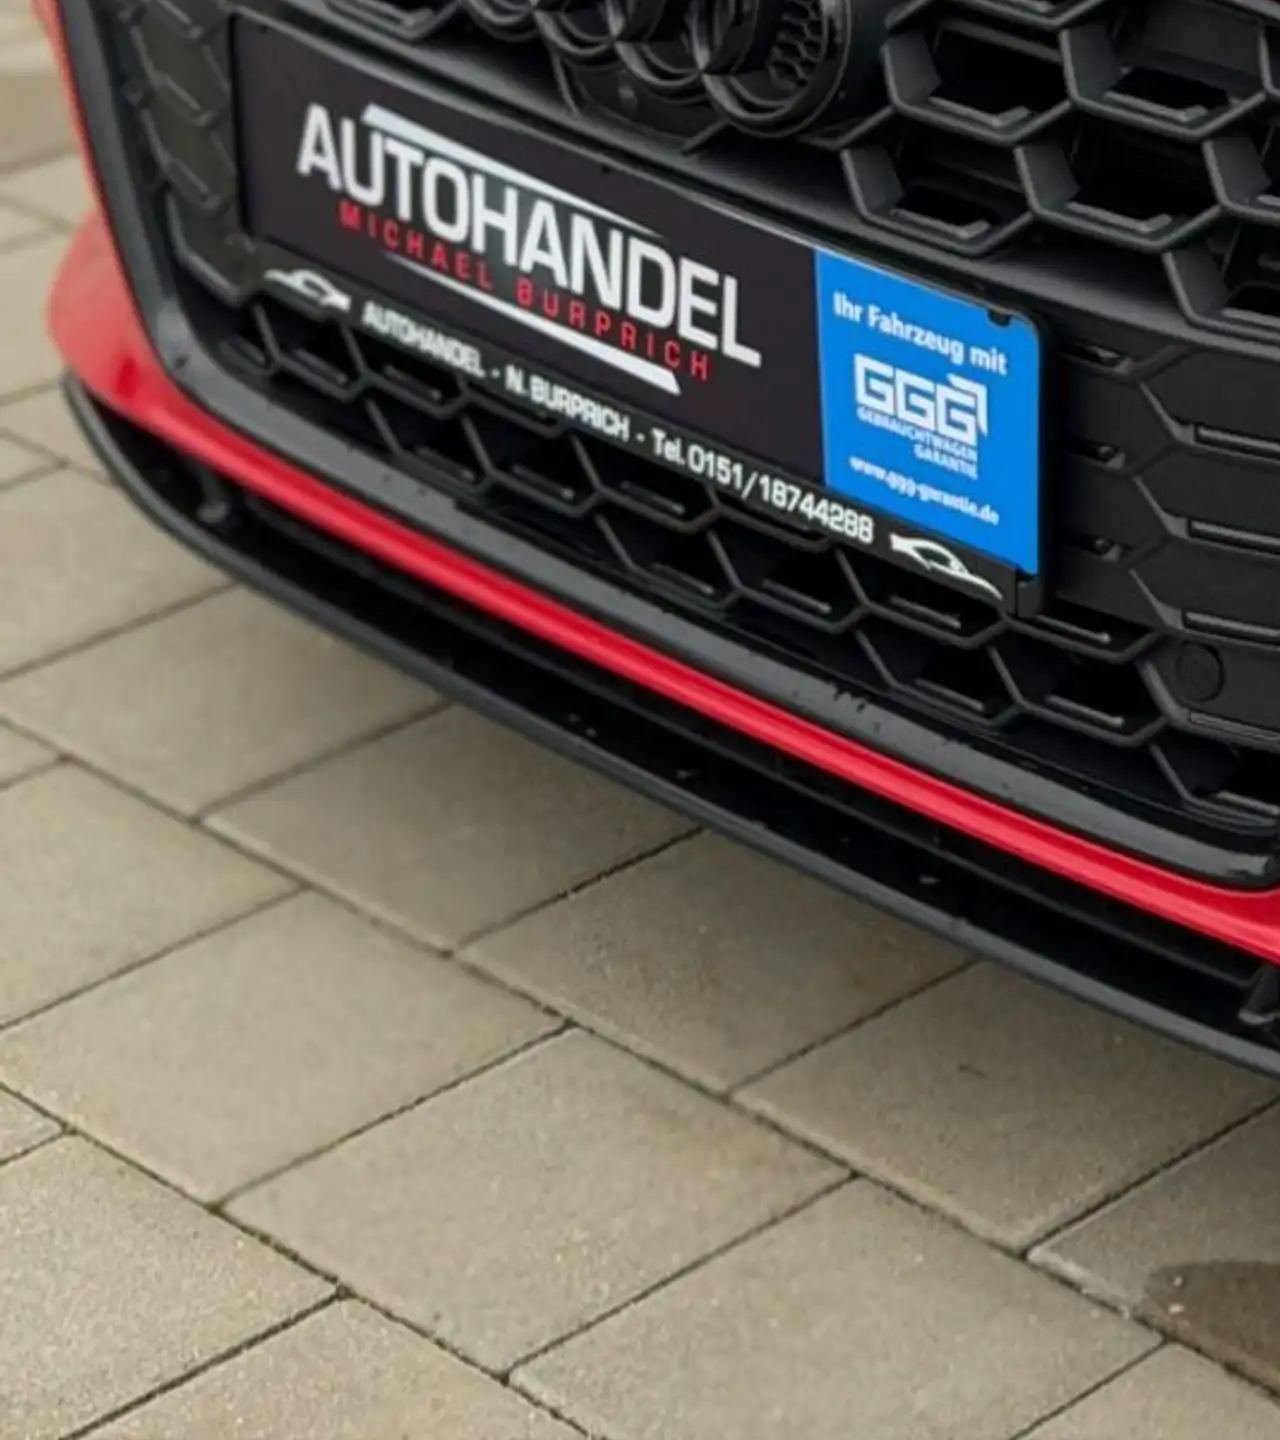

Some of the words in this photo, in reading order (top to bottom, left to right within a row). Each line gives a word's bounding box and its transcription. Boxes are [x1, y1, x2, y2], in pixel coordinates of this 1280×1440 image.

[297, 102, 762, 368] AUTOHANDEL
[338, 199, 493, 290] MICHAEL
[516, 276, 709, 382] BURPRICH
[833, 290, 863, 323] Ihr
[867, 304, 965, 366] Fahrzeug
[969, 345, 1008, 376] mit
[361, 300, 484, 378] AUTOHANDEL
[530, 374, 631, 442] BURPRICH
[687, 444, 875, 544] 0151/18744288
